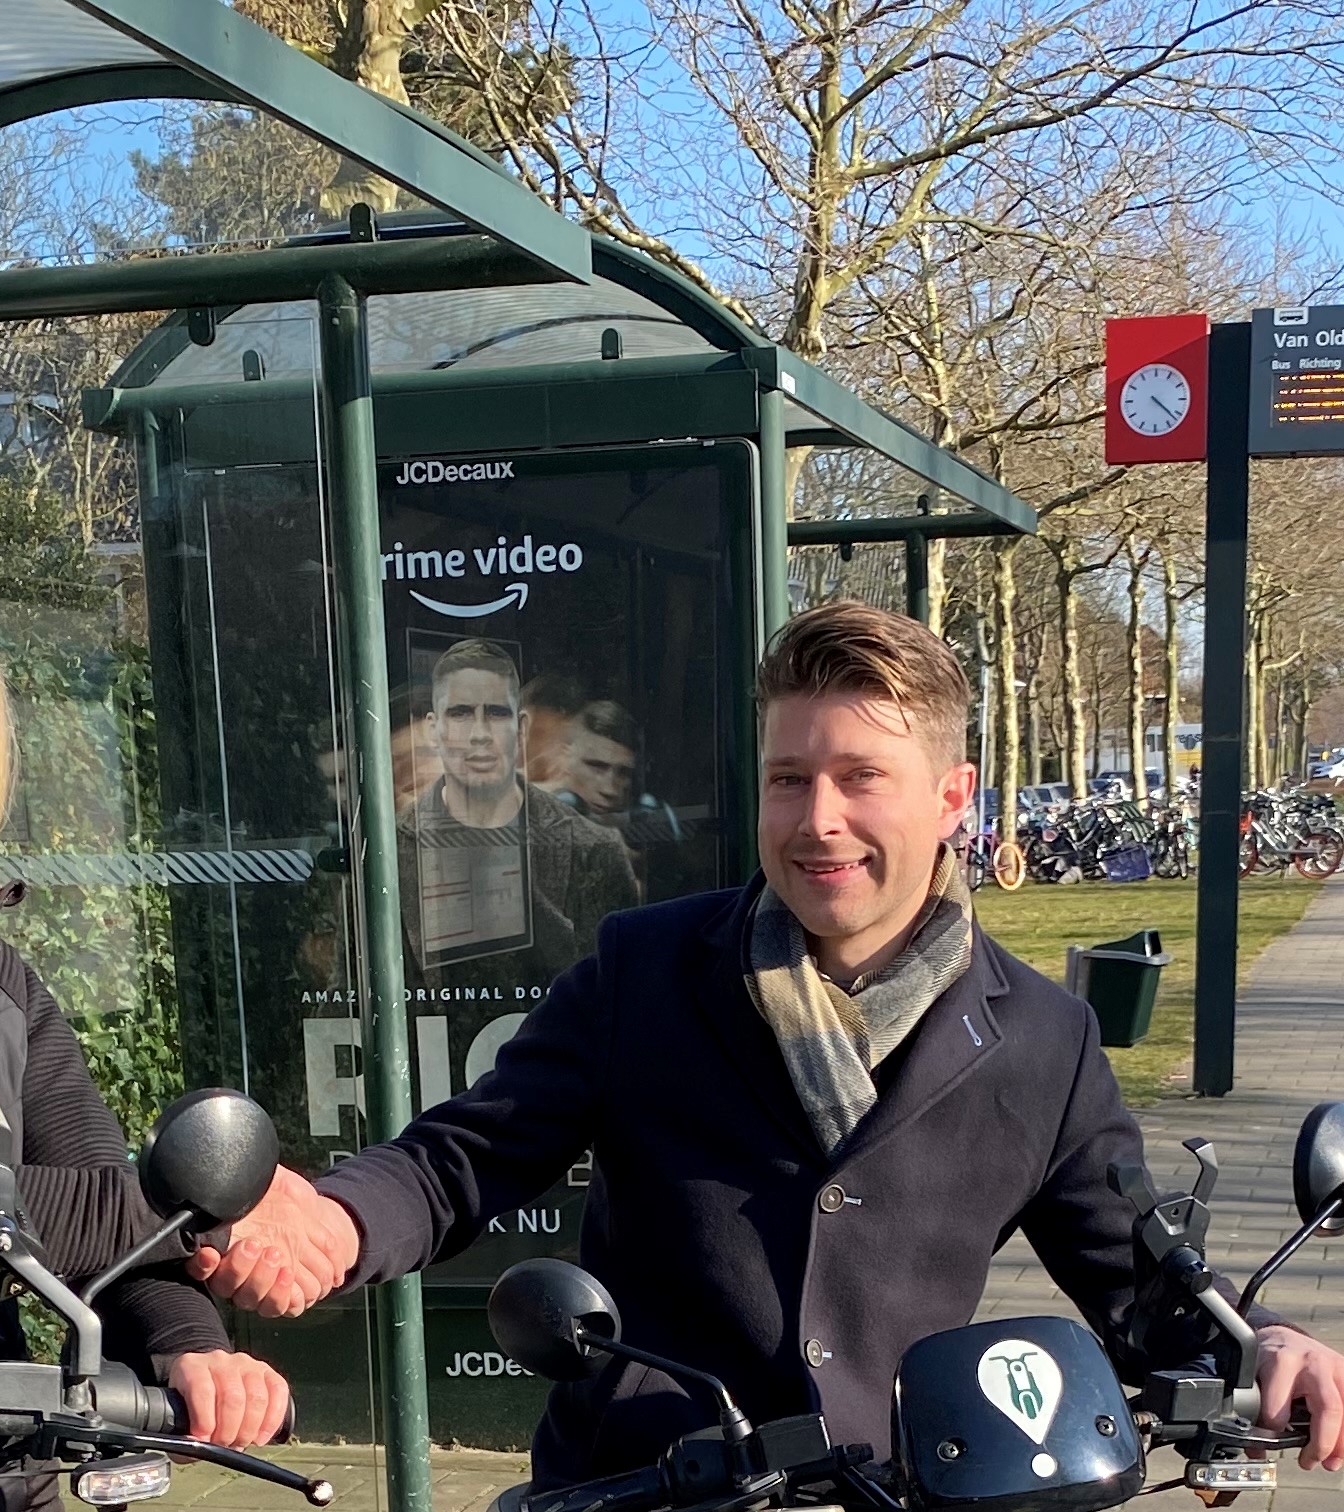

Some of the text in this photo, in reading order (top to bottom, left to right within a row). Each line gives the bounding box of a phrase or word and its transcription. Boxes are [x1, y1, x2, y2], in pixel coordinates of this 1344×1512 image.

[1273, 332, 1309, 348] Van
[1271, 358, 1342, 370] Bus Richting
[396, 461, 515, 485] JCDecaux
[380, 535, 583, 581] rime video
[405, 987, 503, 1001] ORIGINAL
[518, 1208, 561, 1234] NU
